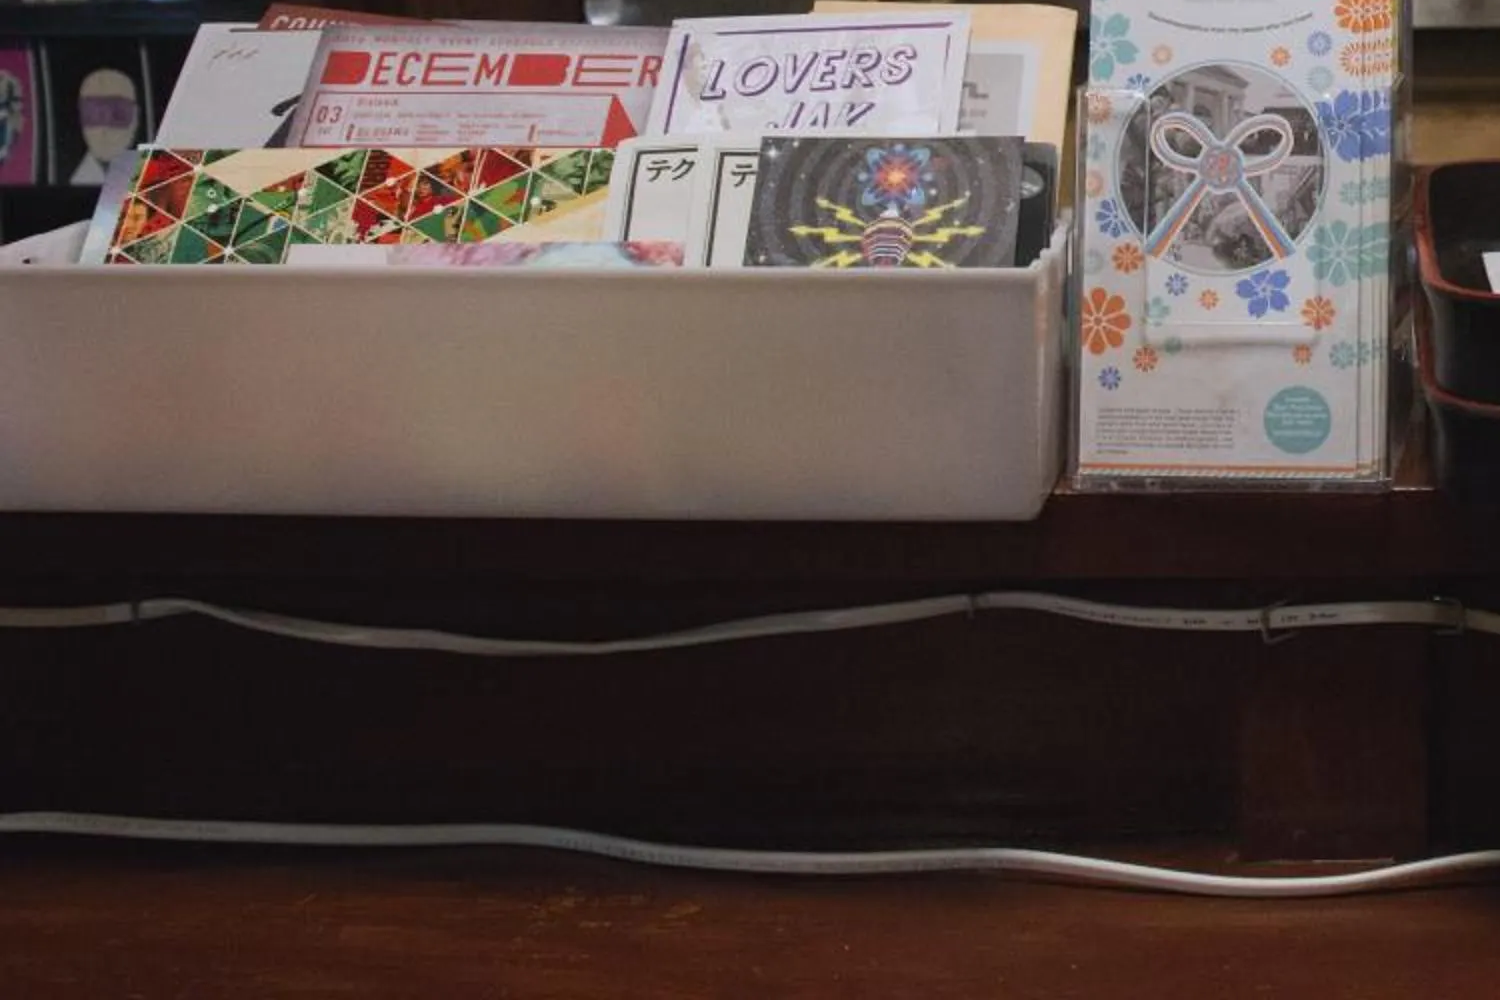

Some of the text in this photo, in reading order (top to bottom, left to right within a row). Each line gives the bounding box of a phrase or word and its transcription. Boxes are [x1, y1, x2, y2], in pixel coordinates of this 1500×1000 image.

[320, 50, 663, 87] DECEMBER
[700, 44, 917, 99] LOVERS
[317, 105, 342, 123] 03
